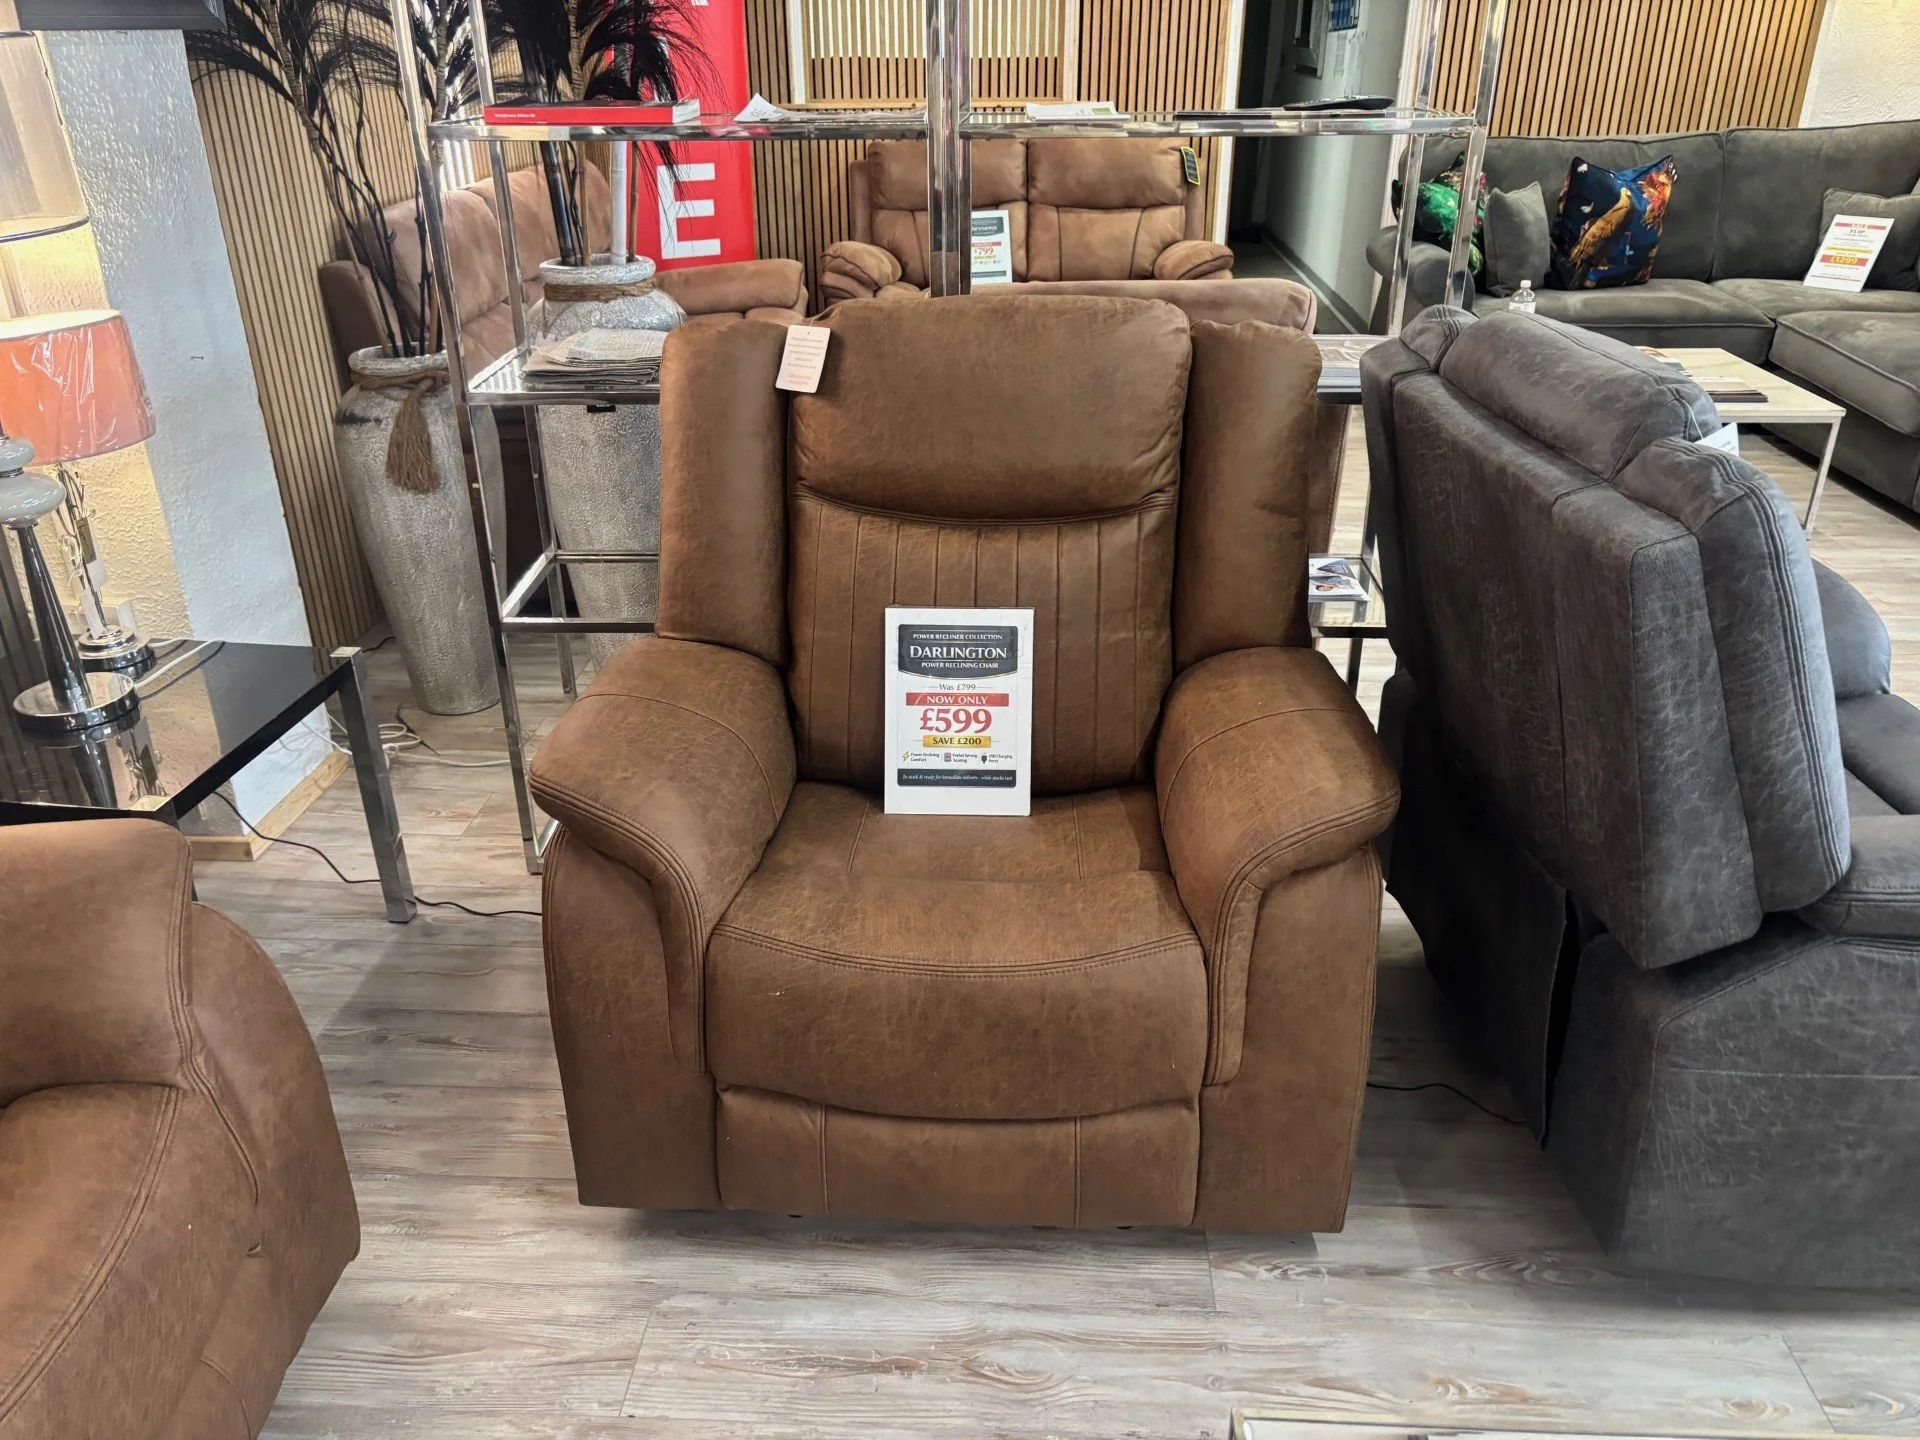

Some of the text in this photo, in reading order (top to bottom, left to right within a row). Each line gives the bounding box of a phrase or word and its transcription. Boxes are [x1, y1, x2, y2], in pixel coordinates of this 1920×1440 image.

[1829, 255, 1858, 265] £1299
[909, 645, 1008, 659] DARLINGTON
[939, 683, 976, 691] Was £799
[926, 695, 988, 705] NOW ONLY
[919, 708, 992, 734] £599
[932, 737, 982, 745] SAVE £200
